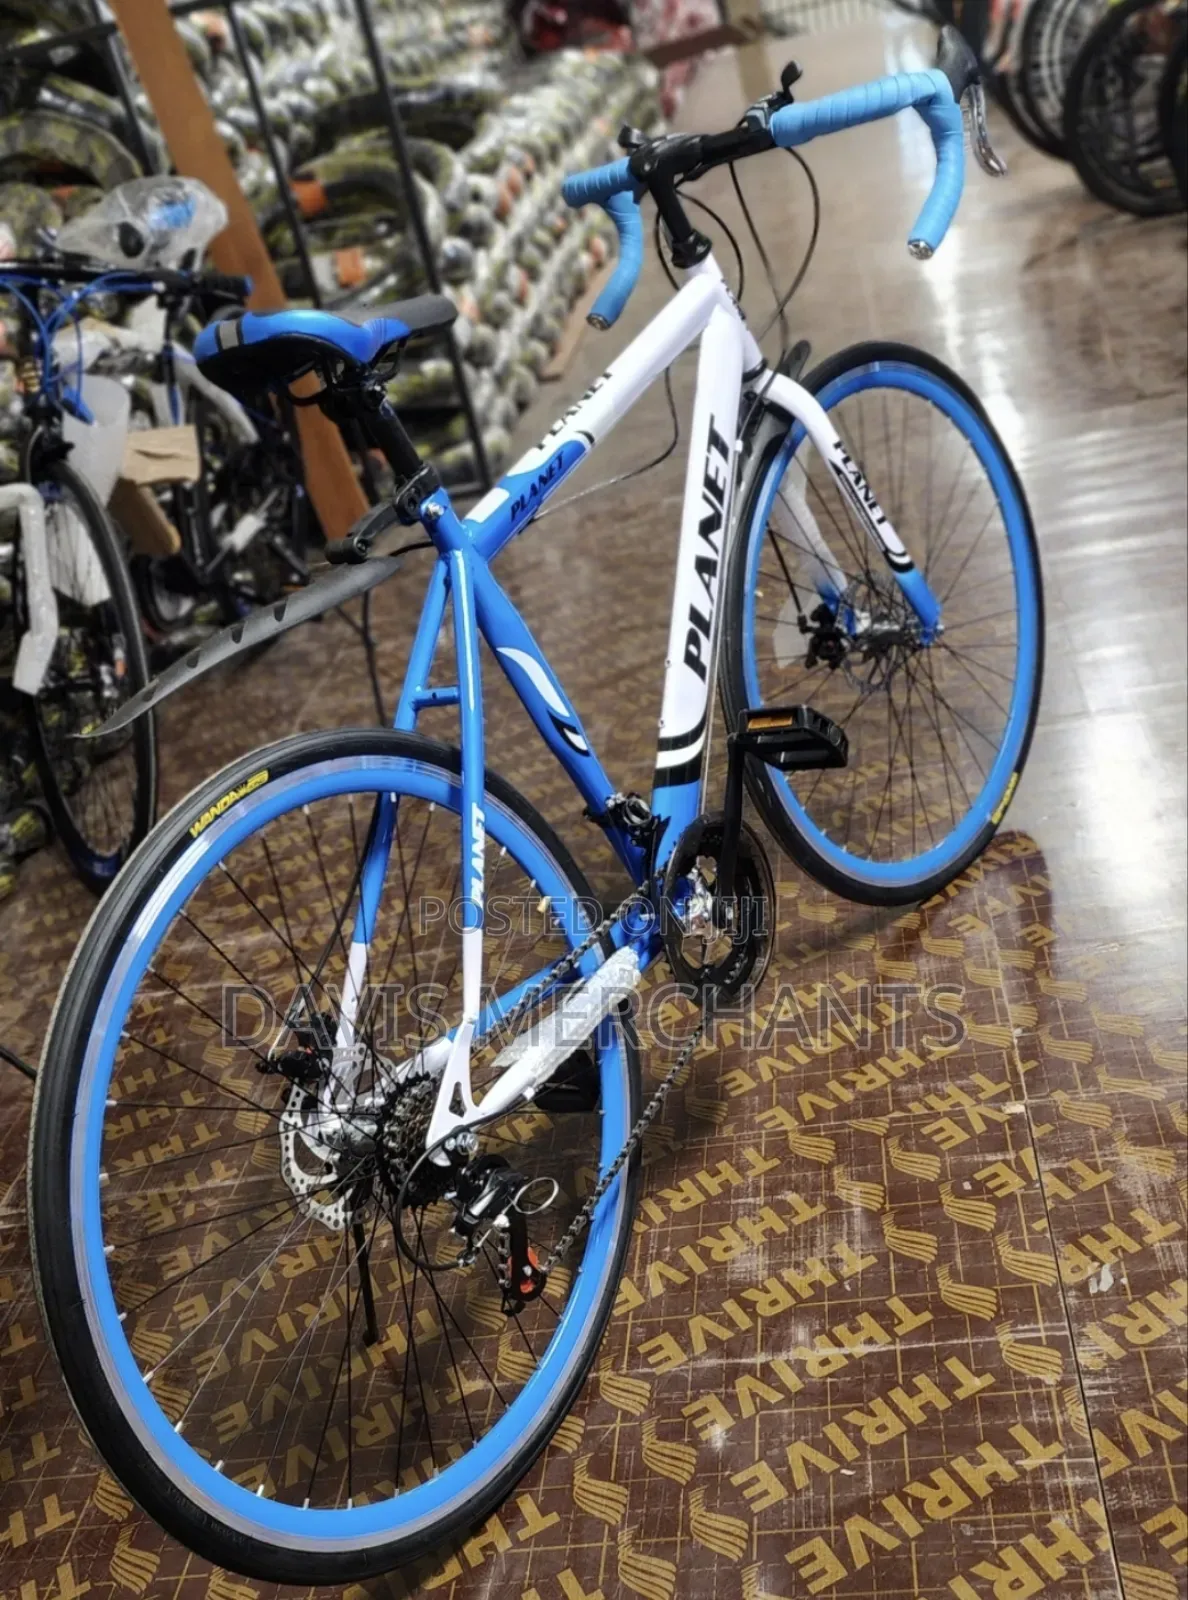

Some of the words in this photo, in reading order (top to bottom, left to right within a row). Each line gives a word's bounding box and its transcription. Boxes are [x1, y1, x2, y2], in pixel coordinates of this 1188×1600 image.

[510, 451, 564, 522] PLANET
[683, 412, 730, 685] PLANET
[610, 1192, 828, 1317] THRIVE
[637, 1240, 879, 1377] THRIVE
[681, 1295, 934, 1442] THRIVE
[729, 1356, 996, 1514] THRIVE
[784, 1423, 1066, 1596] THRIVE
